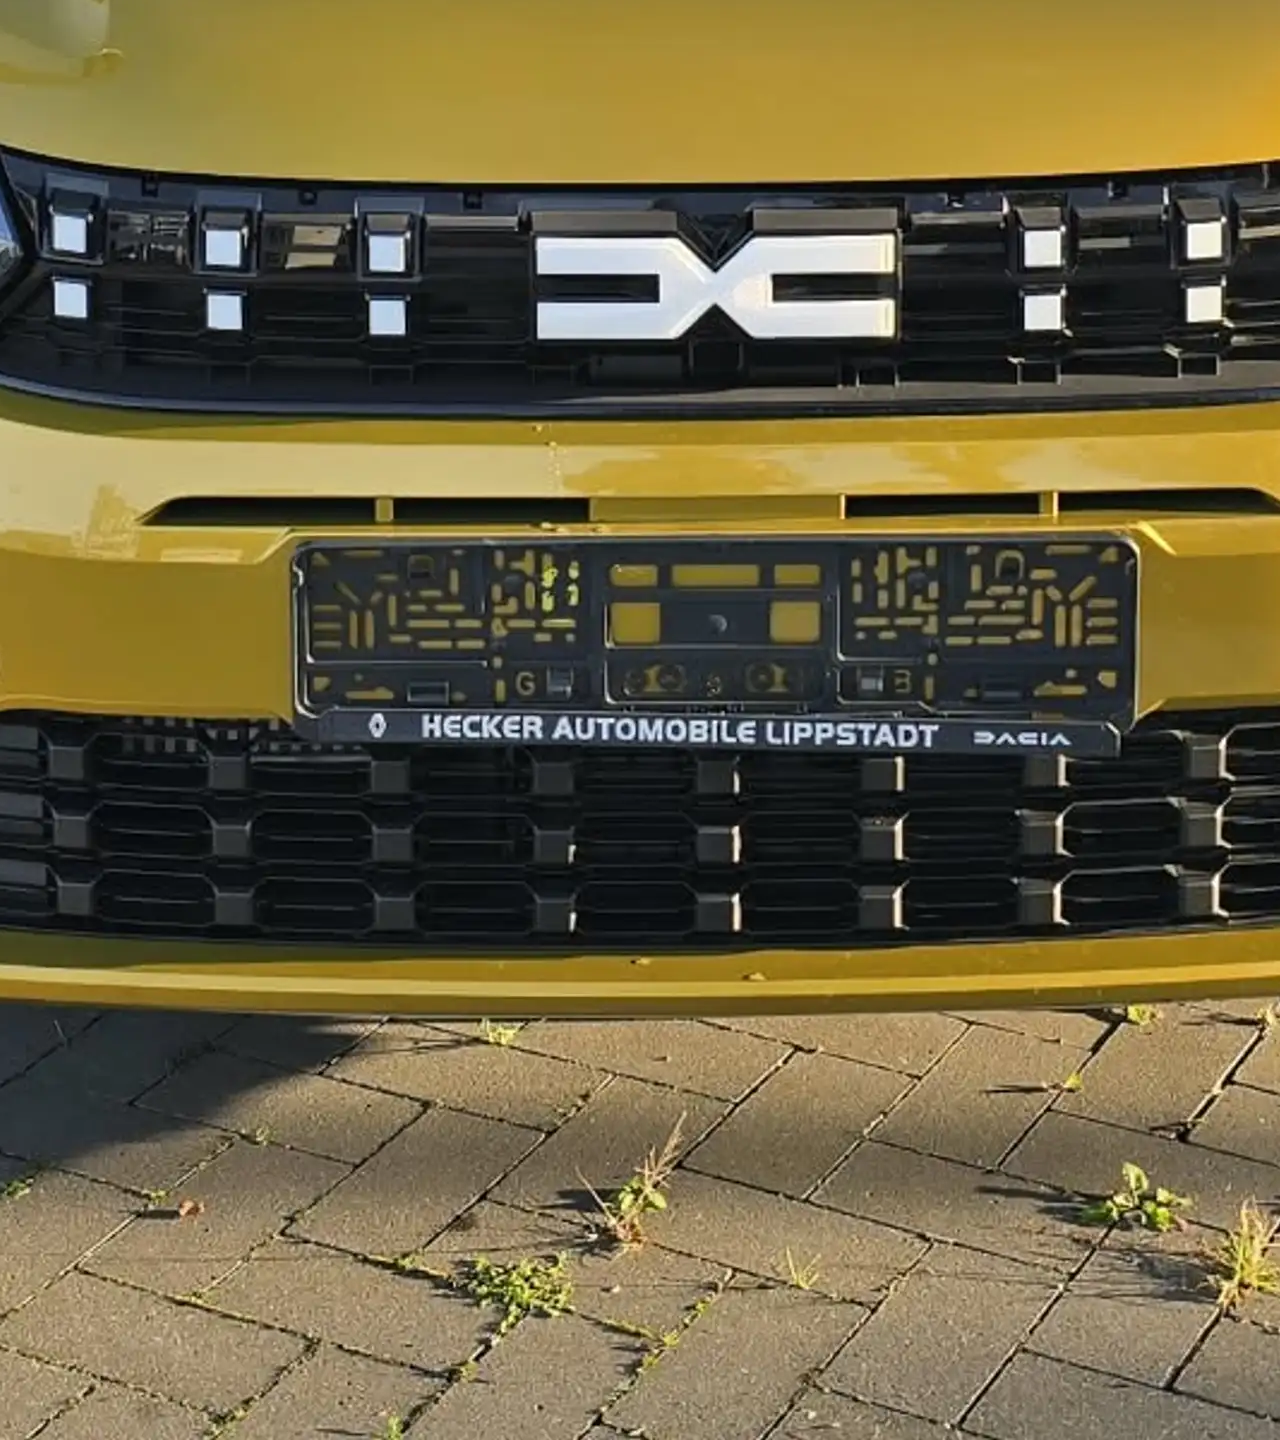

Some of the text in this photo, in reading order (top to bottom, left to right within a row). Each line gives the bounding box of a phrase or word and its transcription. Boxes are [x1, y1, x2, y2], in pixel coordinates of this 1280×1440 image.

[422, 714, 939, 748] HECKER AUTOMOBILE LIPPSTADT
[973, 731, 1071, 747] DACIA
